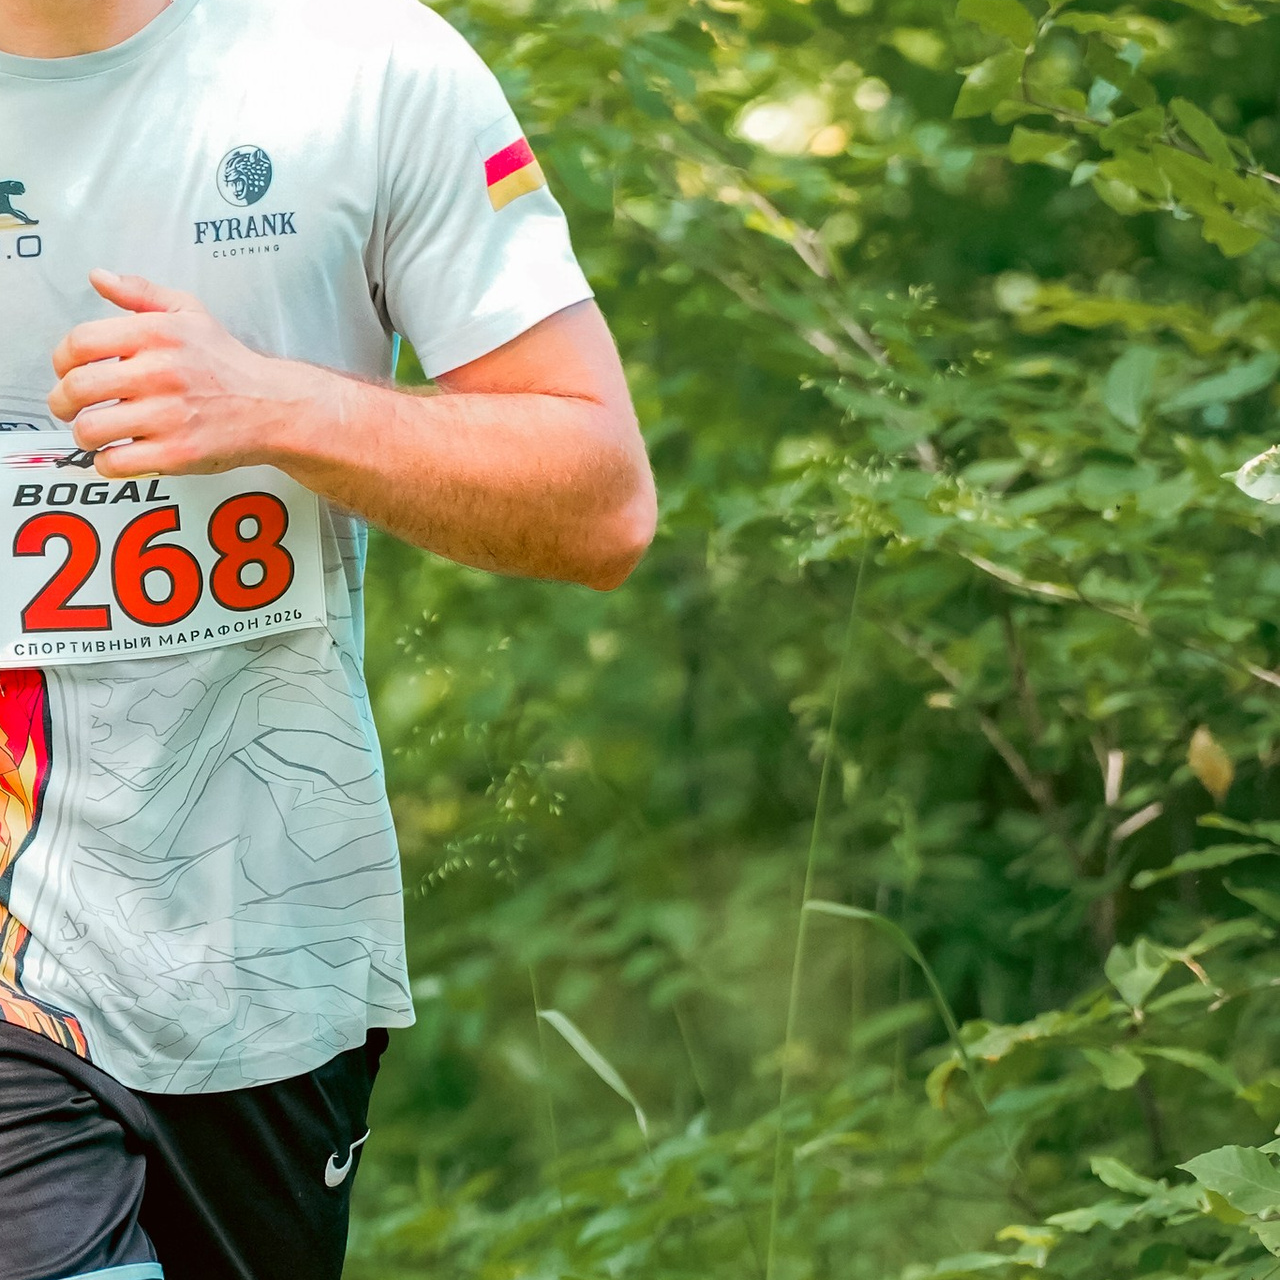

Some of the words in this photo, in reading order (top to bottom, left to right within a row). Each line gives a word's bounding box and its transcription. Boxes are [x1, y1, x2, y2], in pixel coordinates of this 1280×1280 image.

[193, 211, 298, 245] FYRANK
[212, 244, 281, 259] CLOTHING
[12, 479, 171, 507] BOGAL
[12, 491, 295, 633] 268
[14, 635, 152, 657] СПОРТИВНЫЙ
[158, 617, 260, 648] МАРАФОН
[264, 608, 303, 626] 2026
